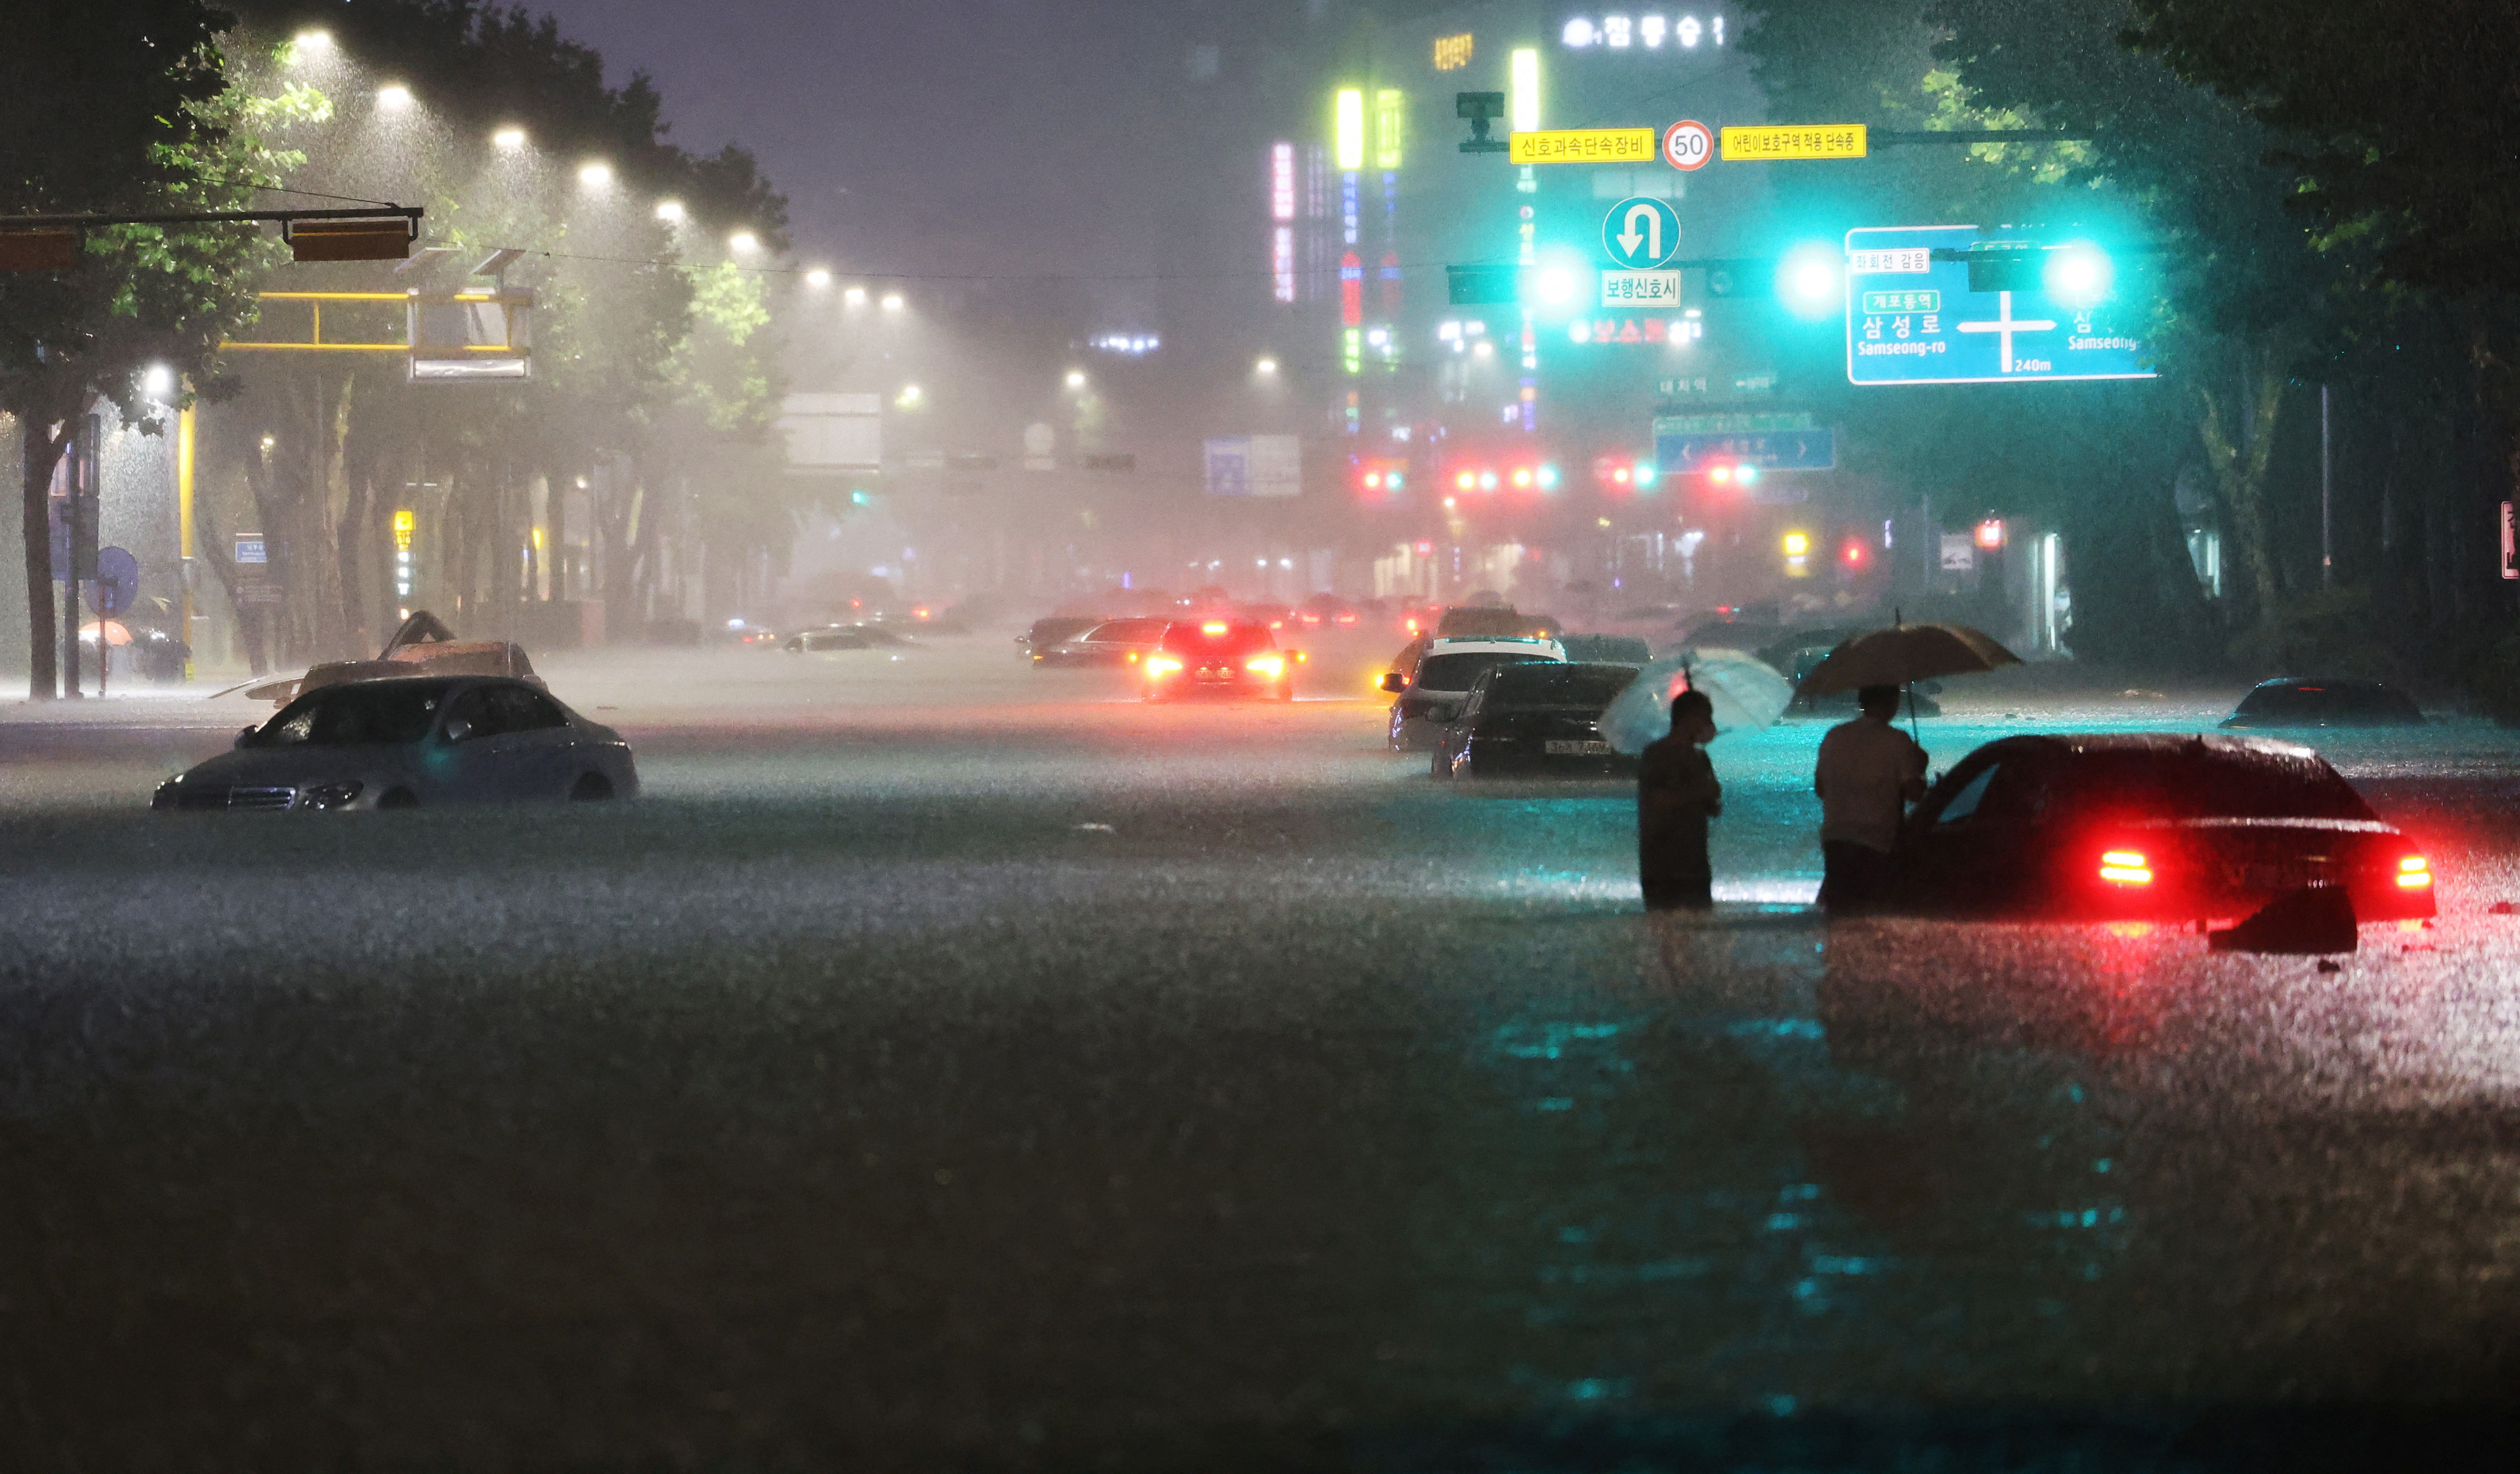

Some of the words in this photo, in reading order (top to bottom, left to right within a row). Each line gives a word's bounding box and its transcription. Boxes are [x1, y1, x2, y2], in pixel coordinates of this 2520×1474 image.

[1522, 136, 1642, 157] 신호과속단속장비
[1675, 135, 1704, 156] 50
[1733, 133, 1800, 153] 어린이보호구역
[1804, 133, 1821, 151] 적용
[1826, 132, 1854, 151] 단속중
[1857, 254, 1893, 270] 좌회전
[1902, 253, 1924, 269] 감응
[1607, 278, 1676, 299] 보행신호시
[1873, 294, 1932, 310] 개포동역
[1862, 315, 1942, 339] 삼성로
[1858, 341, 1946, 357] Samseong-ro
[2015, 359, 2051, 372] 240m
